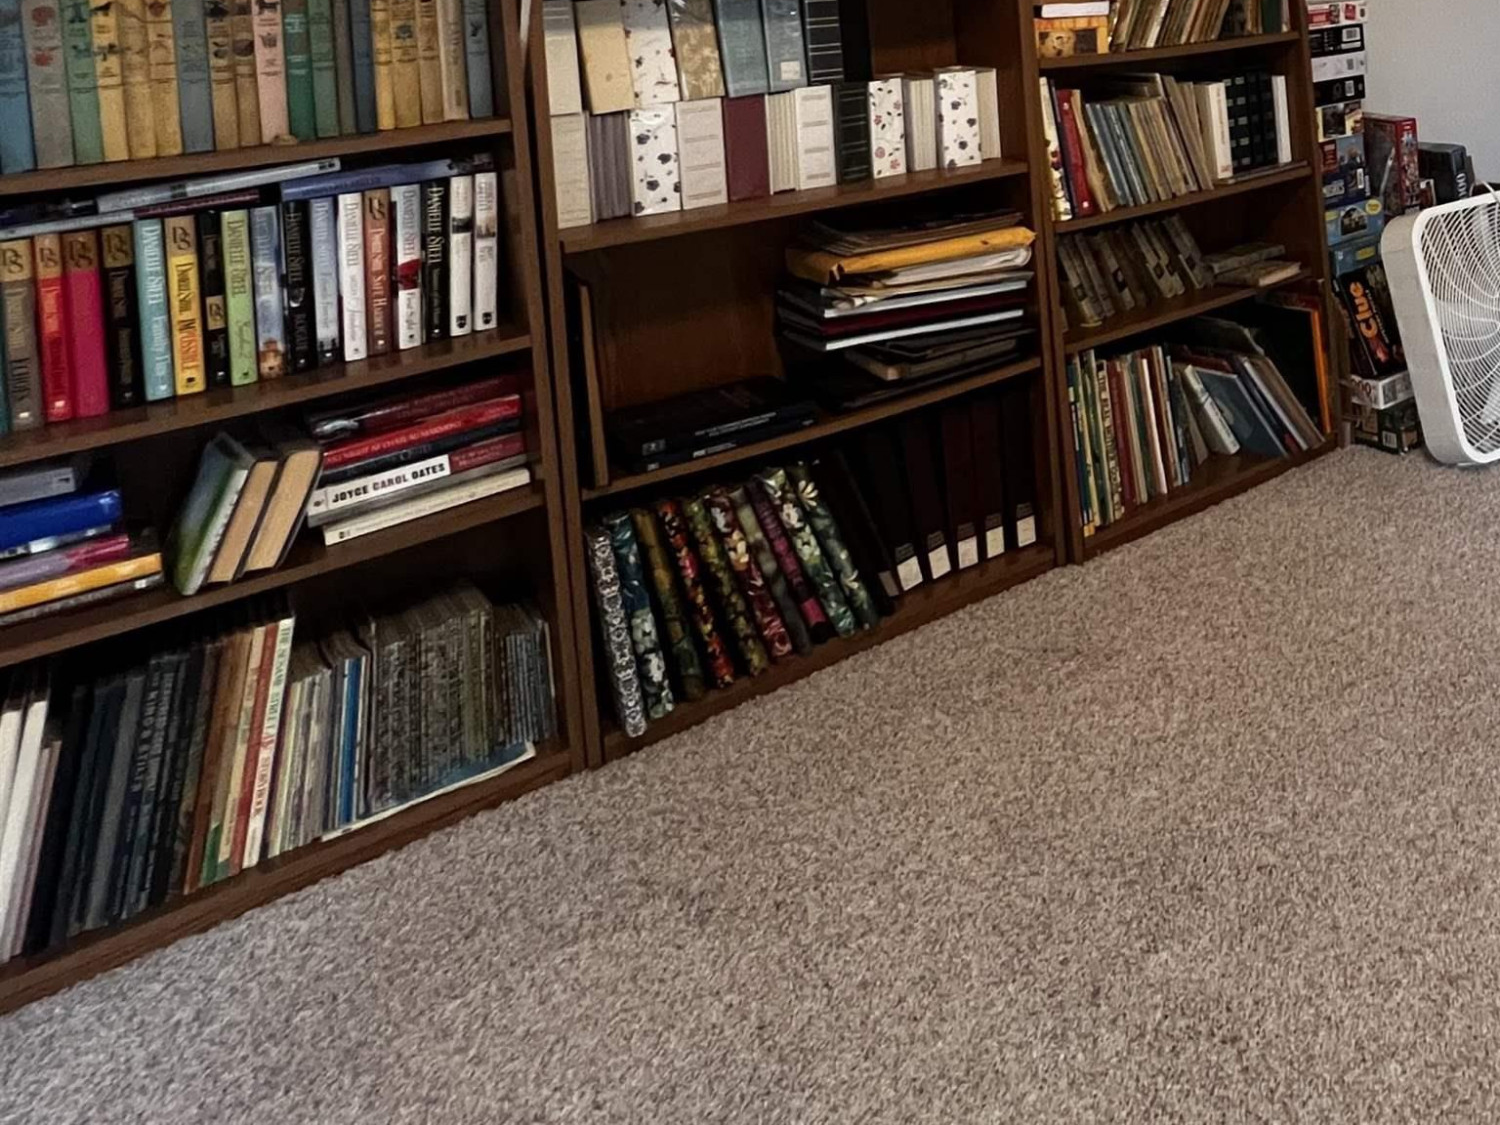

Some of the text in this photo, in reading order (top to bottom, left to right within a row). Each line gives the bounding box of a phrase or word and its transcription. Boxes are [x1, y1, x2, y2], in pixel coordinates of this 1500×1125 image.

[426, 186, 444, 232] DANIELLE
[428, 232, 445, 265] STEEL
[1350, 281, 1378, 339] Clue
[178, 318, 199, 372] IMPOSSIBLE
[331, 462, 446, 504] JOYCE CAROL OATES
